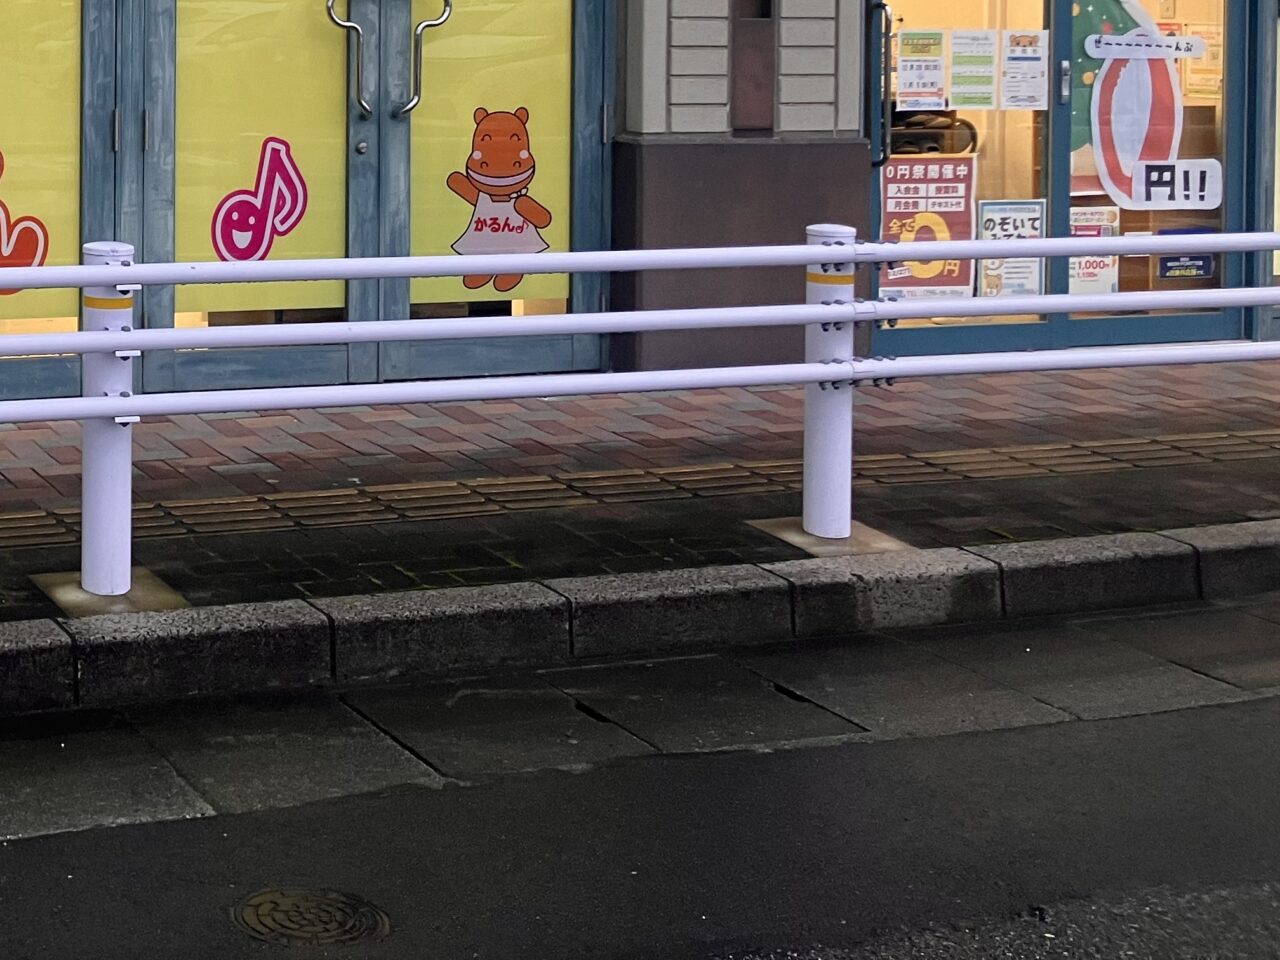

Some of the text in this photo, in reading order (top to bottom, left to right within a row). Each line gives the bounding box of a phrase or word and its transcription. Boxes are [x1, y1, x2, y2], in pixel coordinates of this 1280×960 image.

[886, 164, 969, 180] 0円祭開催中
[894, 185, 920, 195] 入会金
[984, 216, 1041, 233] のぞいて
